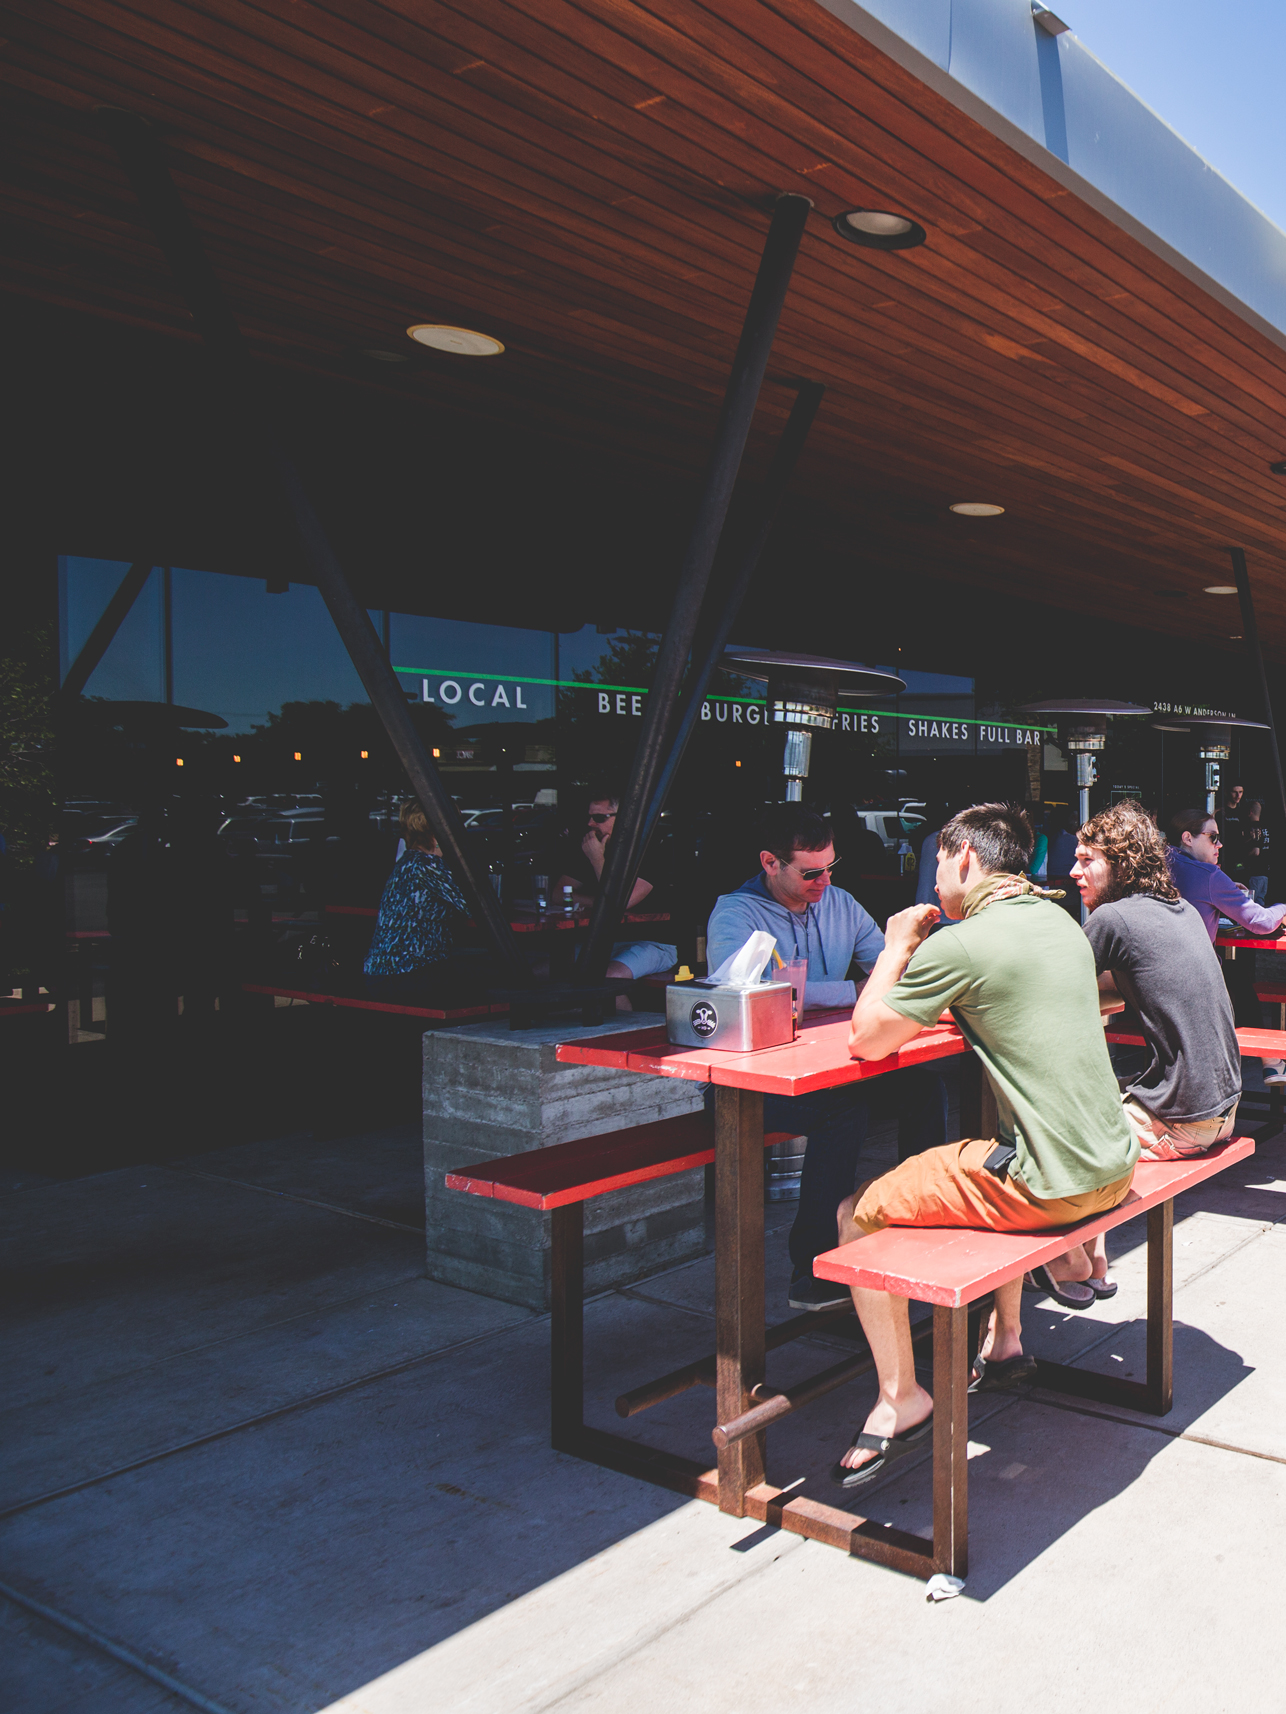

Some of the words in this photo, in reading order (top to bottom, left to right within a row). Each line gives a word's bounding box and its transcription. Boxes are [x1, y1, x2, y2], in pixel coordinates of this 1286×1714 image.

[422, 679, 527, 709] LOCAL
[599, 692, 642, 717] BEE
[701, 702, 769, 725] BURG
[1153, 701, 1171, 713] 2438
[1184, 705, 1192, 715] W
[908, 719, 968, 740] SHAKES
[980, 725, 1012, 744] FULL
[1016, 729, 1041, 746] BAR
